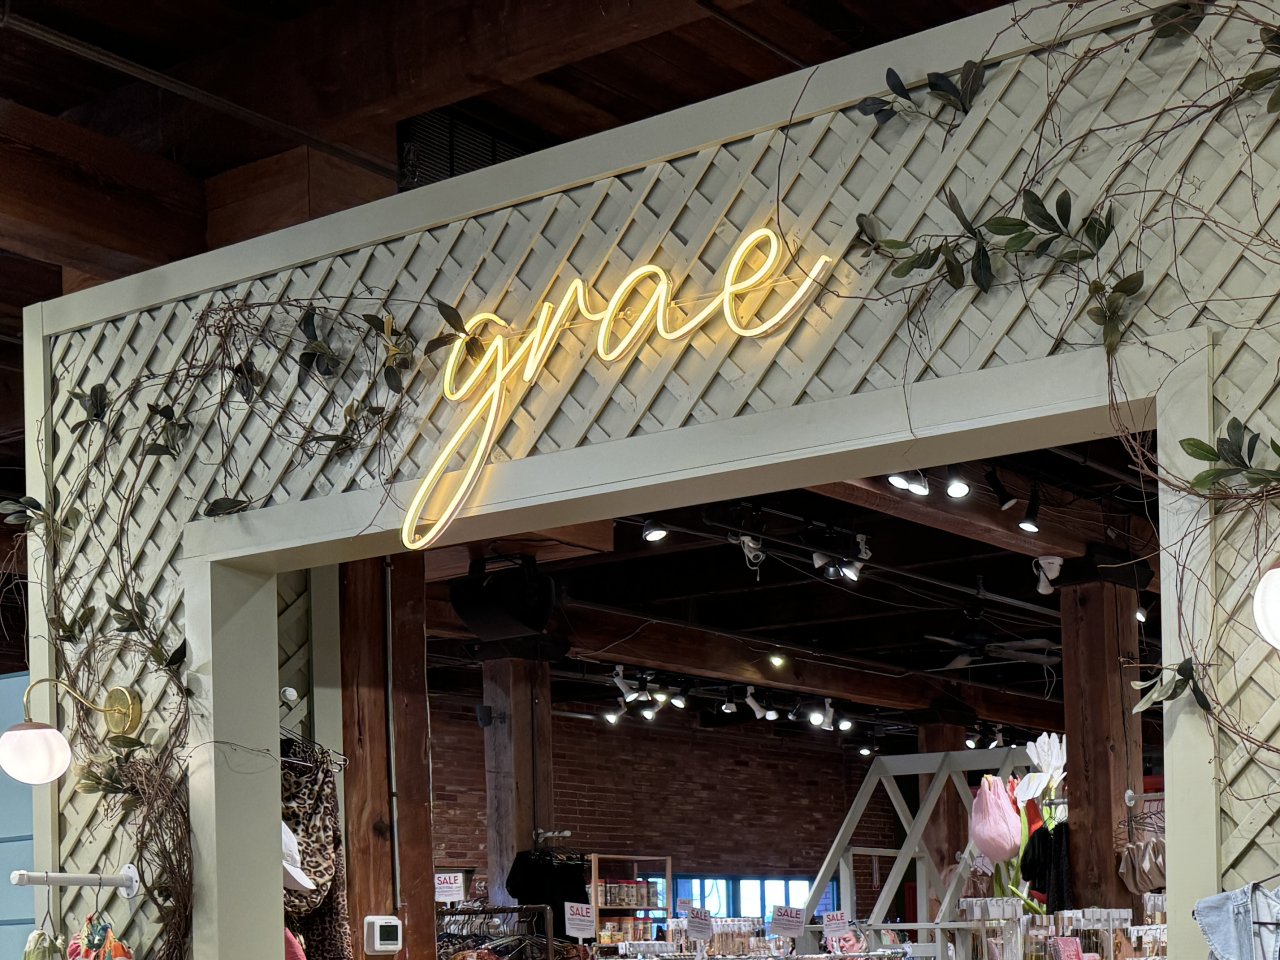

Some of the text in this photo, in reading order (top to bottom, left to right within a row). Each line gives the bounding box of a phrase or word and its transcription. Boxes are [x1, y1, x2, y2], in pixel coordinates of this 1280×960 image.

[402, 228, 832, 549] grae
[437, 875, 459, 885] SALE
[569, 906, 591, 917] SALE
[690, 910, 708, 921] SALE
[777, 907, 801, 919] SALE
[826, 912, 845, 922] SALE
